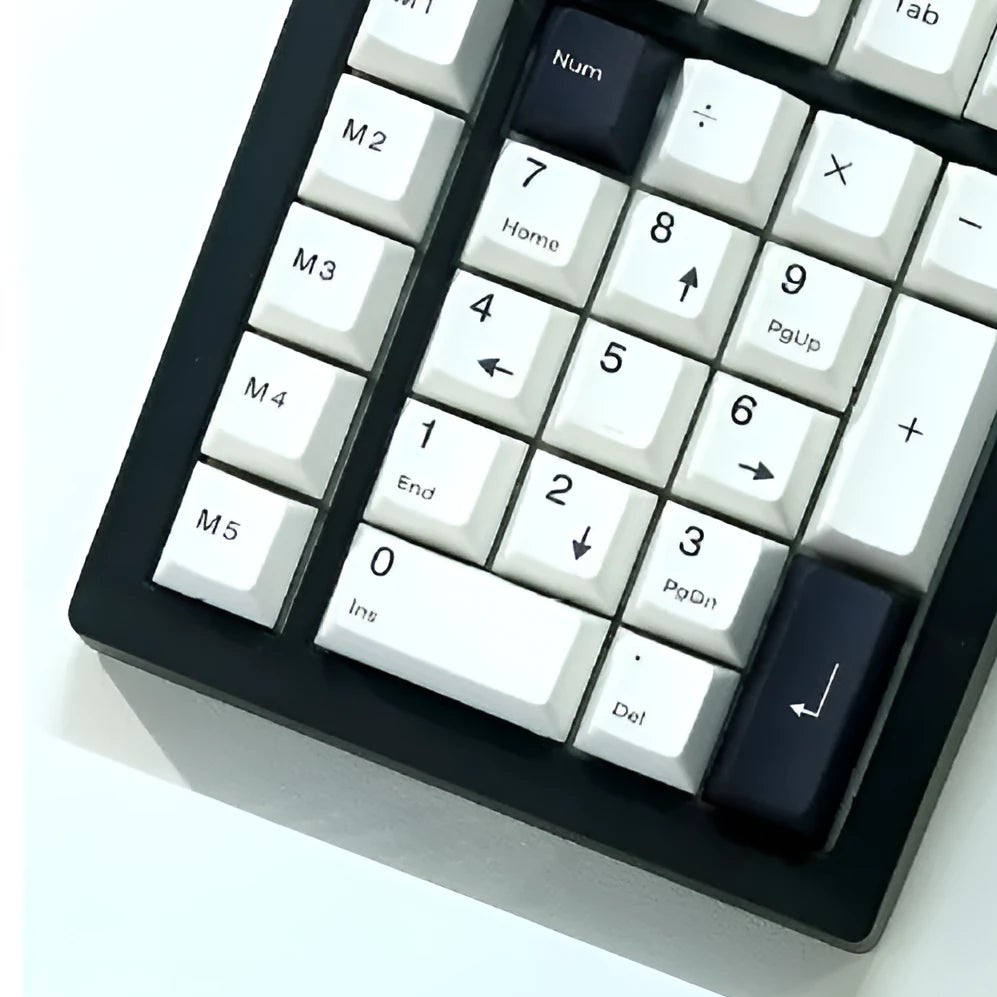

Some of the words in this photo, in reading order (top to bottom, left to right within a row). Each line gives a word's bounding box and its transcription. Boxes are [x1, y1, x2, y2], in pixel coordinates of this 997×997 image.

[553, 49, 602, 81] Num
[343, 119, 386, 152] M2
[523, 156, 547, 188] 7
[502, 218, 559, 252] Home
[651, 212, 674, 243] 8
[293, 248, 336, 280] M3
[782, 264, 806, 294] 9
[470, 294, 494, 322] 4
[768, 319, 820, 352] PgUp
[600, 342, 626, 373] 5
[244, 377, 287, 408] M4
[731, 395, 757, 425] 6
[421, 420, 435, 448] 1
[398, 475, 435, 499] End
[546, 474, 572, 505] 2
[196, 509, 240, 540] M5
[679, 526, 704, 556] 3
[371, 547, 394, 576] 0
